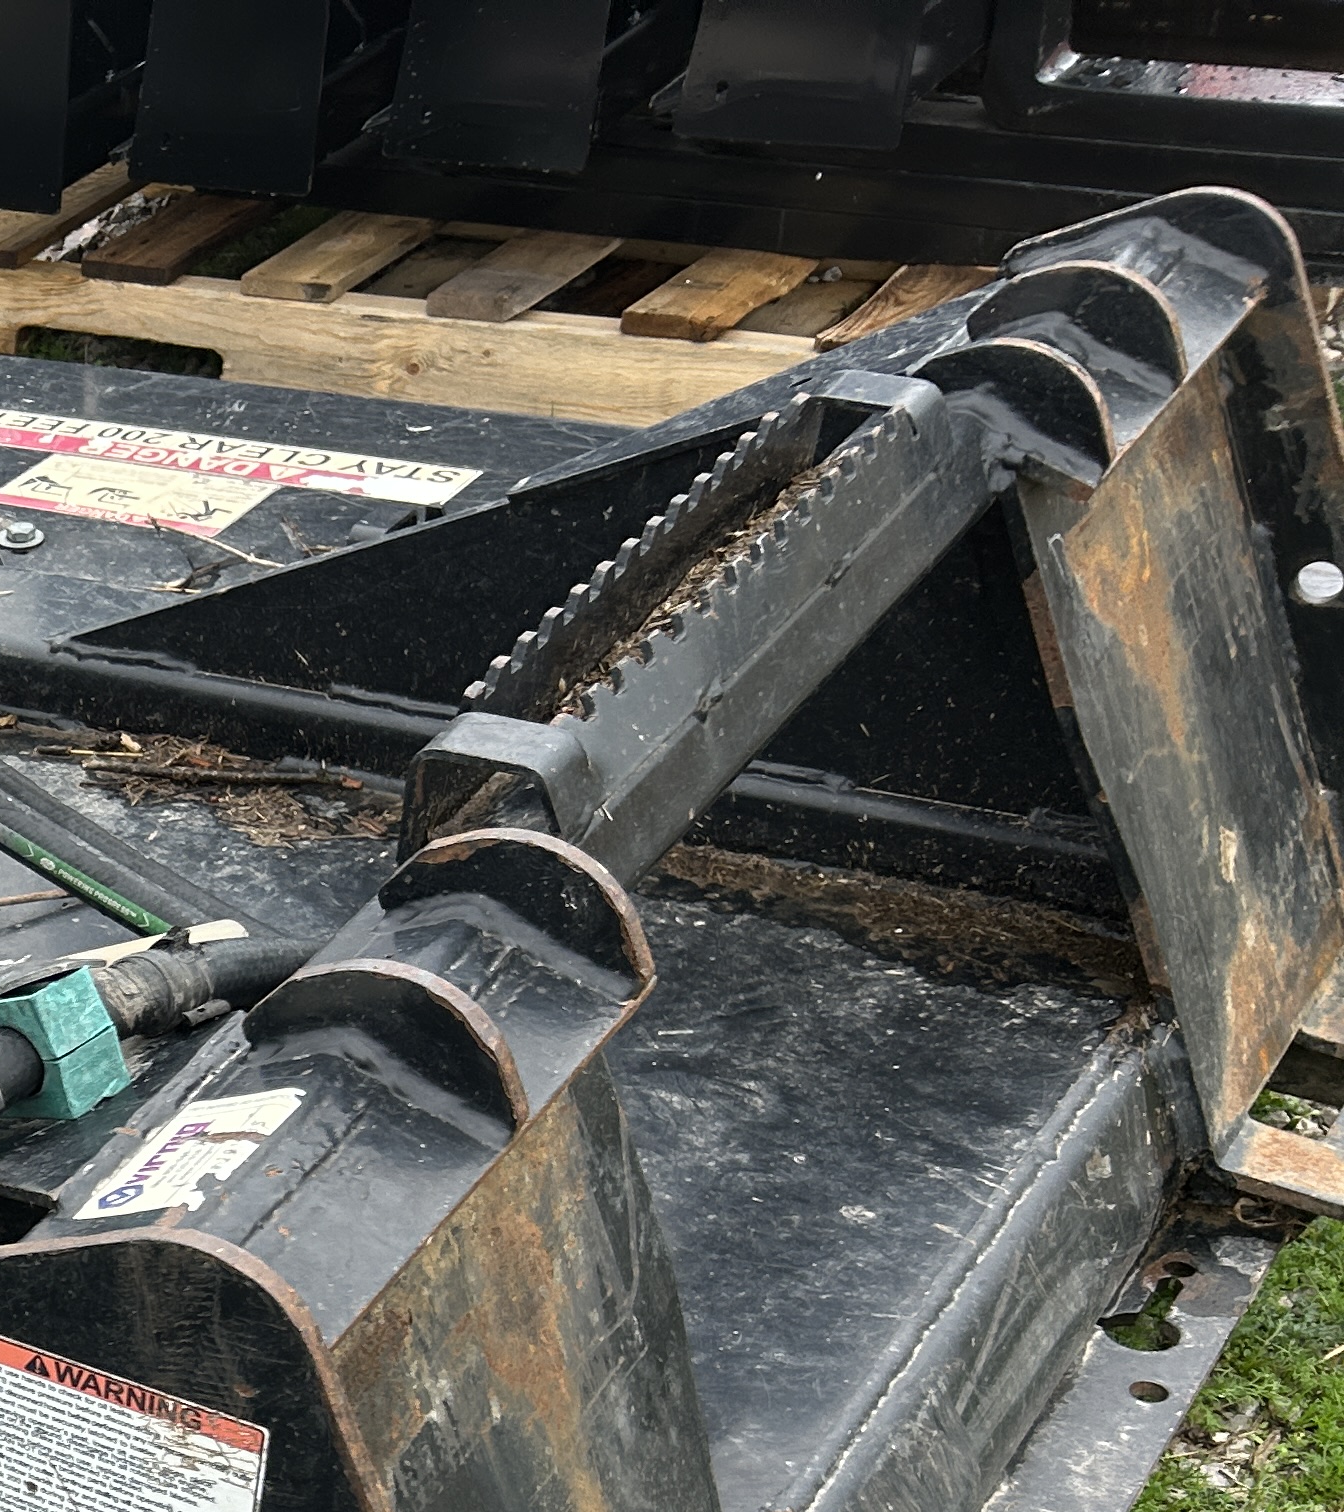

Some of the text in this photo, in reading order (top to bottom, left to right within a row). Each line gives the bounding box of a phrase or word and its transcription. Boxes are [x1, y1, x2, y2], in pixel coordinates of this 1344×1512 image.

[97, 425, 173, 445] 200
[78, 442, 262, 475] DANGER
[174, 437, 335, 467] CLEAR
[336, 457, 464, 484] STAY
[55, 1362, 202, 1431] WARNING
